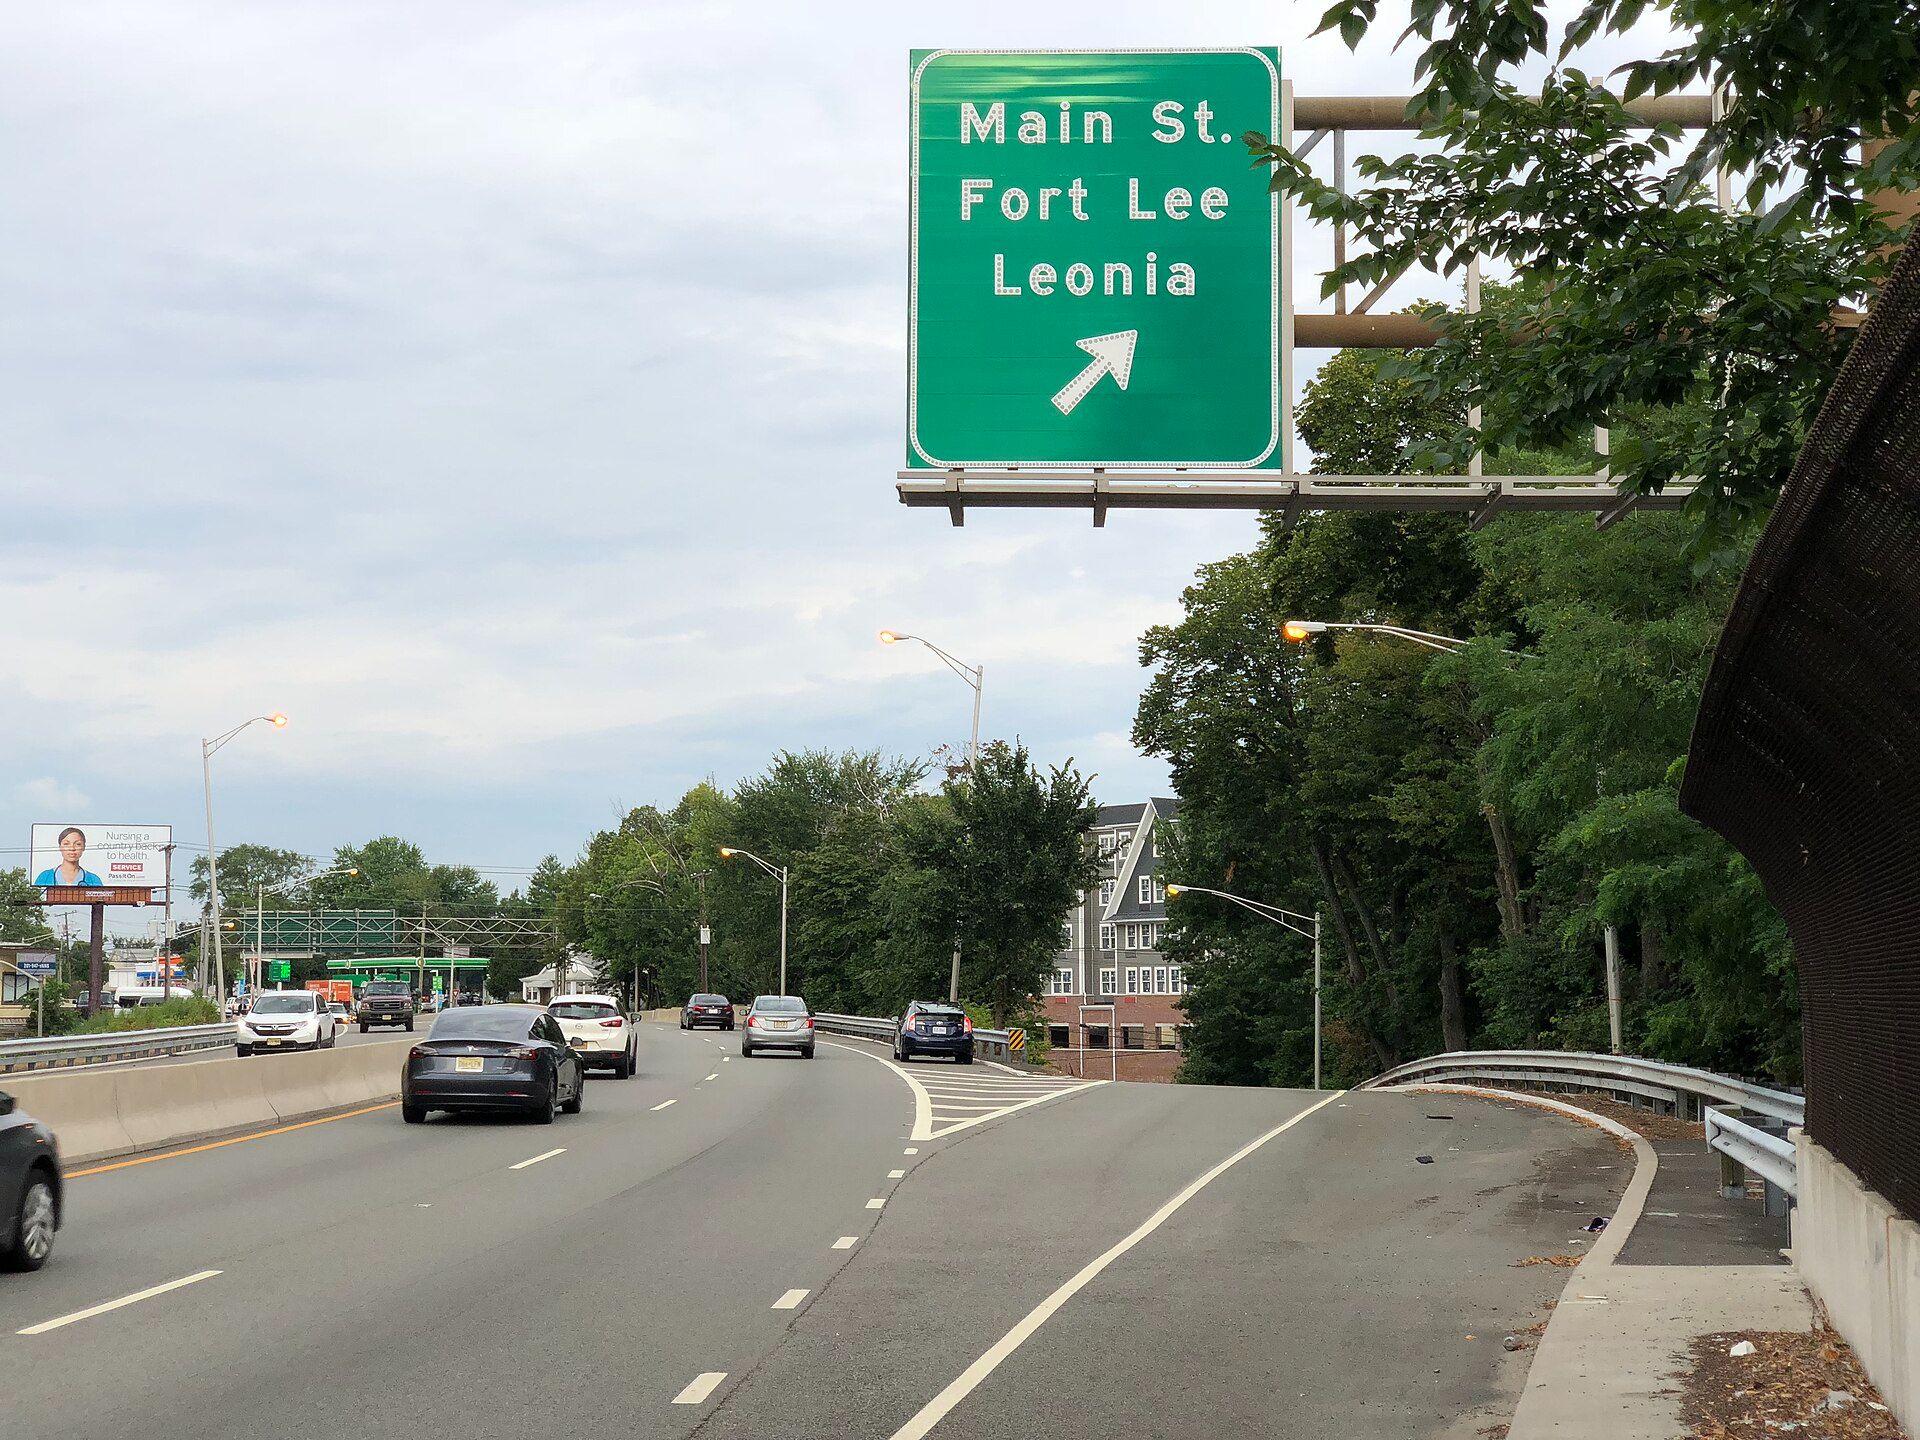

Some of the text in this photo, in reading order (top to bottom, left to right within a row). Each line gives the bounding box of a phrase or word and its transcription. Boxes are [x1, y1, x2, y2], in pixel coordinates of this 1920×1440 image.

[960, 99, 1232, 144] Main St.
[960, 177, 1230, 221] Fort Lee
[993, 252, 1197, 296] Leonia
[97, 842, 159, 852] country back
[106, 831, 141, 842] Nursing
[107, 852, 117, 860] to
